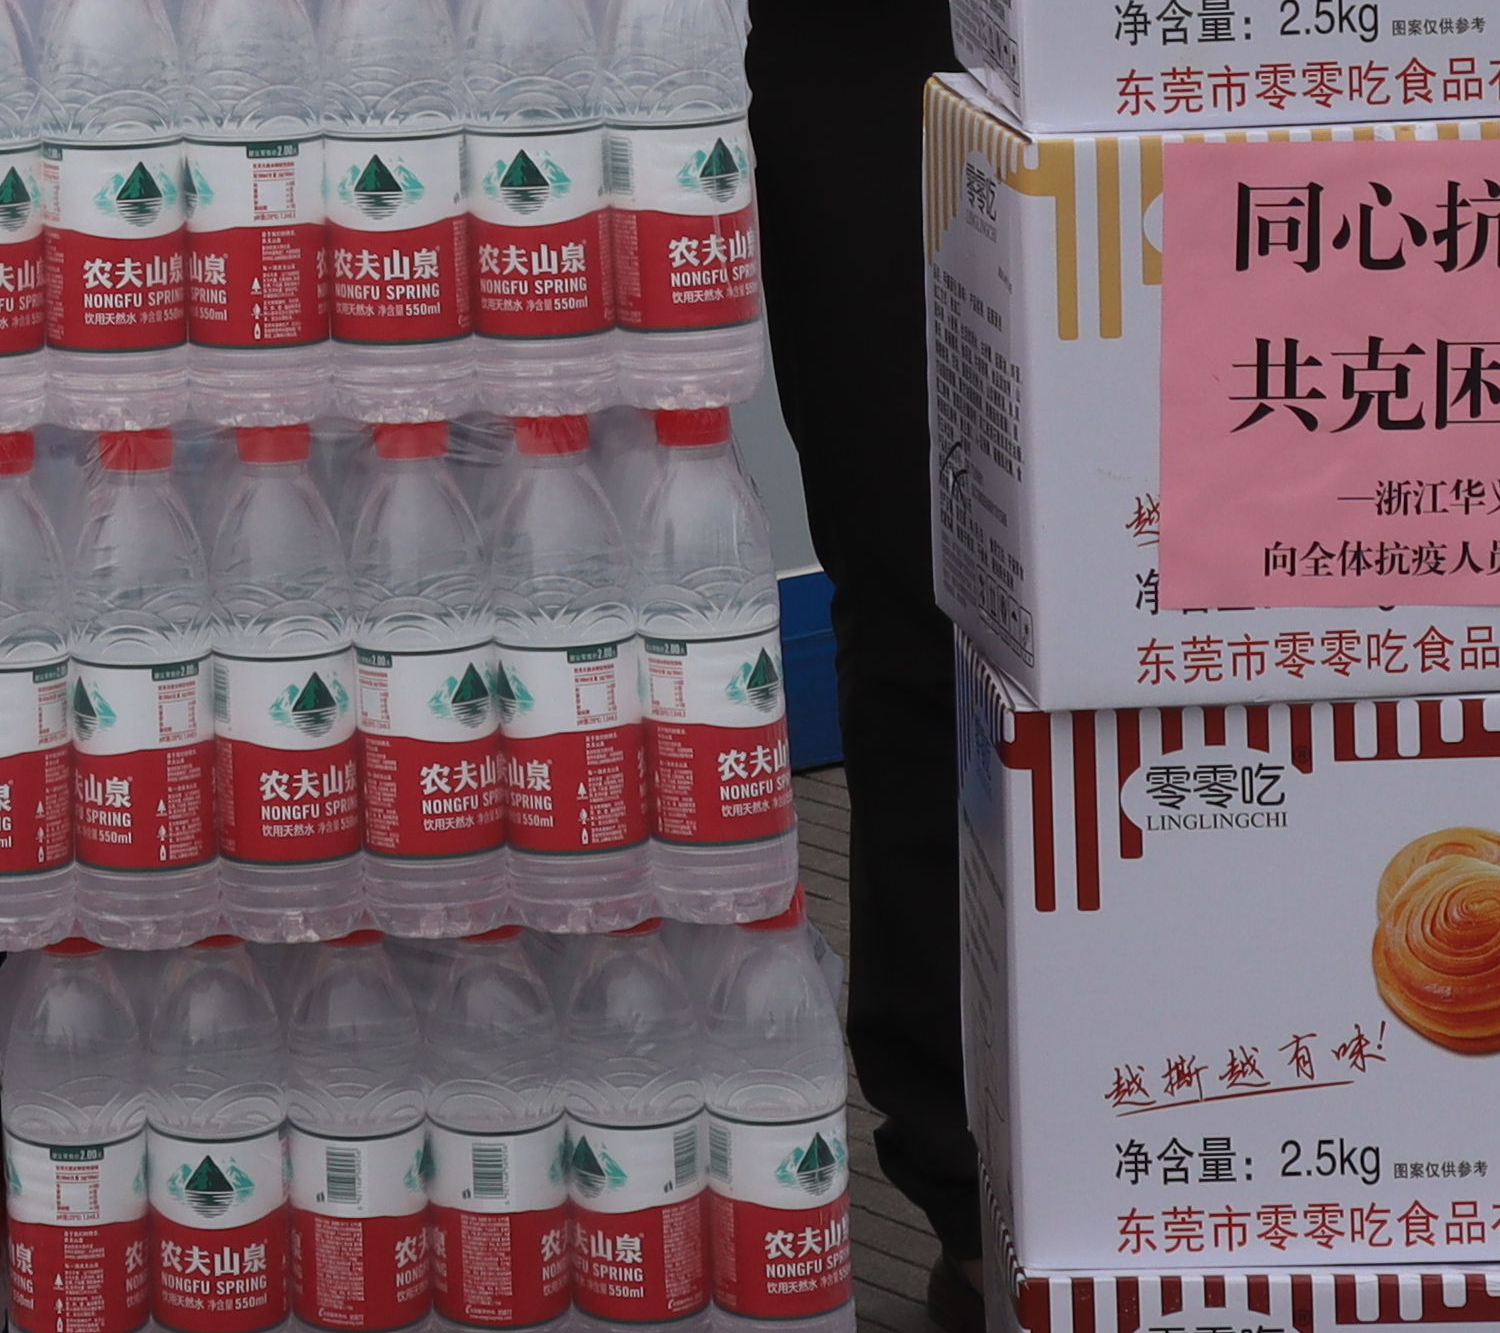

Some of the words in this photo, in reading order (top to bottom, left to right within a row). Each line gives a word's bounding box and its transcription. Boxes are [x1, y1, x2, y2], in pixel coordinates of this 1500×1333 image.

[1390, 15, 1487, 37] 图案仅供参考
[334, 248, 440, 281] 农夫山泉
[479, 242, 587, 276] 农夫山泉
[83, 255, 185, 295] 农夫山泉
[480, 278, 529, 296] NONGFU
[535, 276, 588, 294] SPRING
[670, 271, 728, 288] NONGFU
[84, 293, 143, 309] NONGFU
[335, 283, 381, 300] NONGFU
[386, 282, 440, 299] SPRING
[260, 760, 357, 802] 农夫山泉
[719, 779, 774, 801] NONGFU
[1146, 761, 1287, 811] 零零吃
[261, 803, 321, 821] NONGFU
[421, 795, 479, 815] NONGFU
[1146, 809, 1288, 831] LINGLINGCHI
[1393, 1159, 1489, 1181] 图案仅供参考
[160, 1243, 268, 1277] 农夫山泉
[766, 1259, 823, 1279] NONGFU
[161, 1275, 211, 1296] NONGFU
[216, 1275, 268, 1295] SPRING
